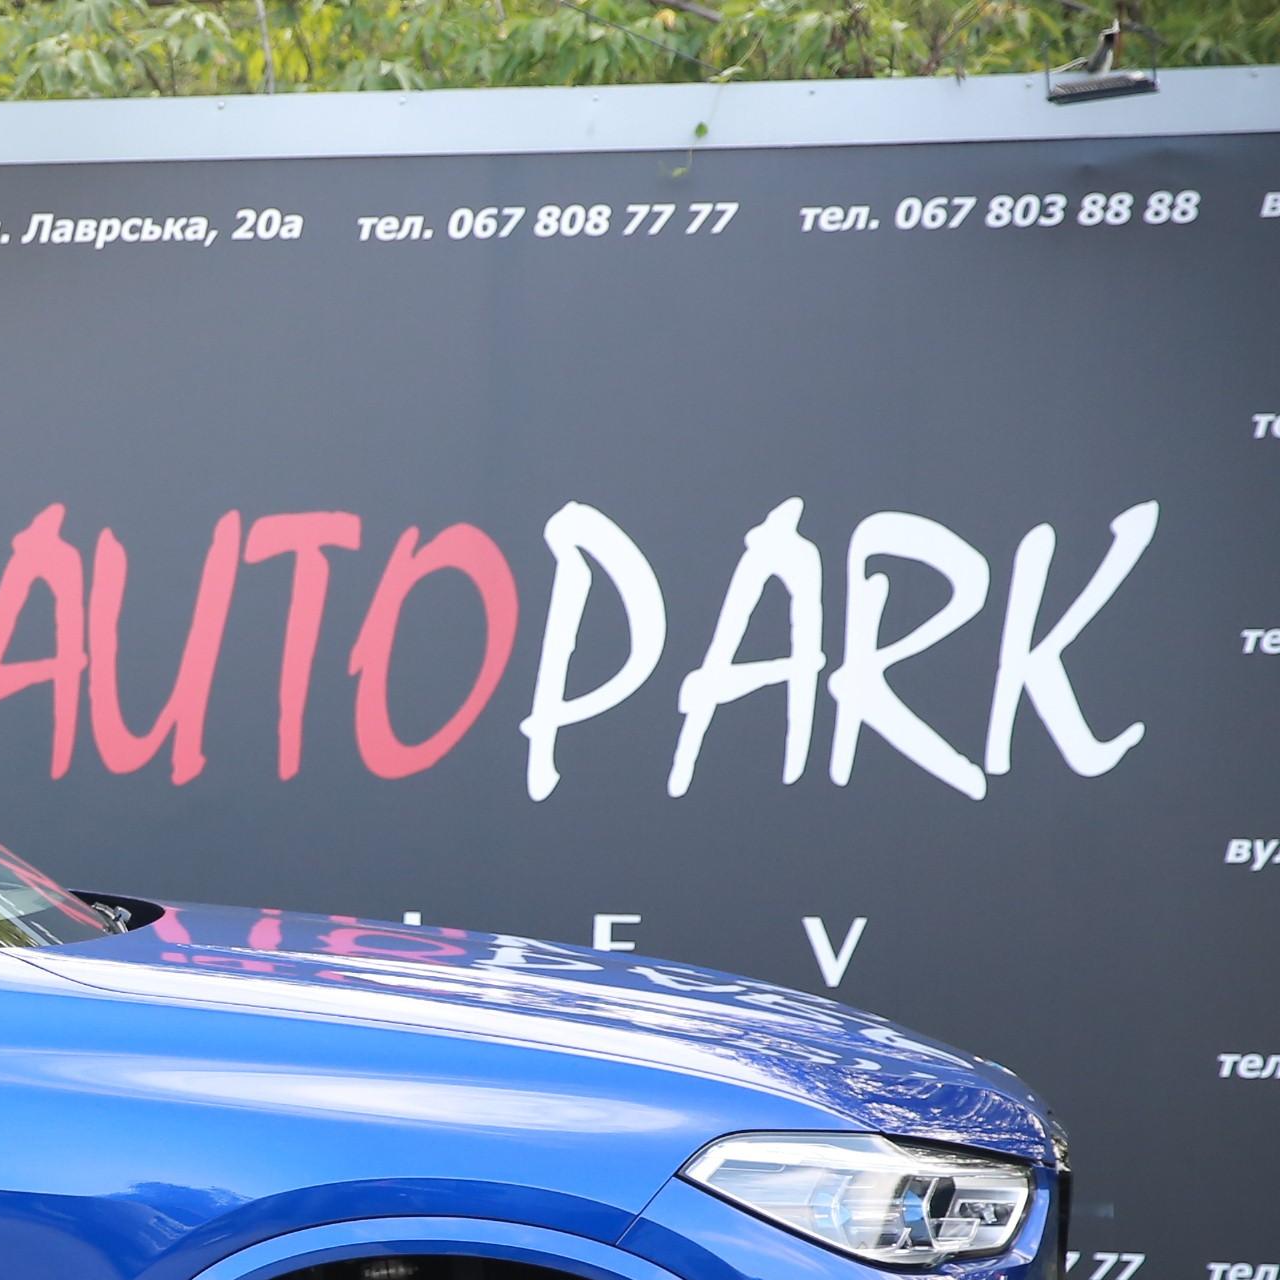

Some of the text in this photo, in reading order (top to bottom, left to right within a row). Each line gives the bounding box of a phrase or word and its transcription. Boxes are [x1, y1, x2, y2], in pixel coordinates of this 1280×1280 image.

[21, 213, 218, 250] Лаврська,
[231, 208, 304, 240] 20а
[357, 202, 739, 243] тел. 067 808 77 77
[800, 191, 1200, 232] тел. 067 803 88 88
